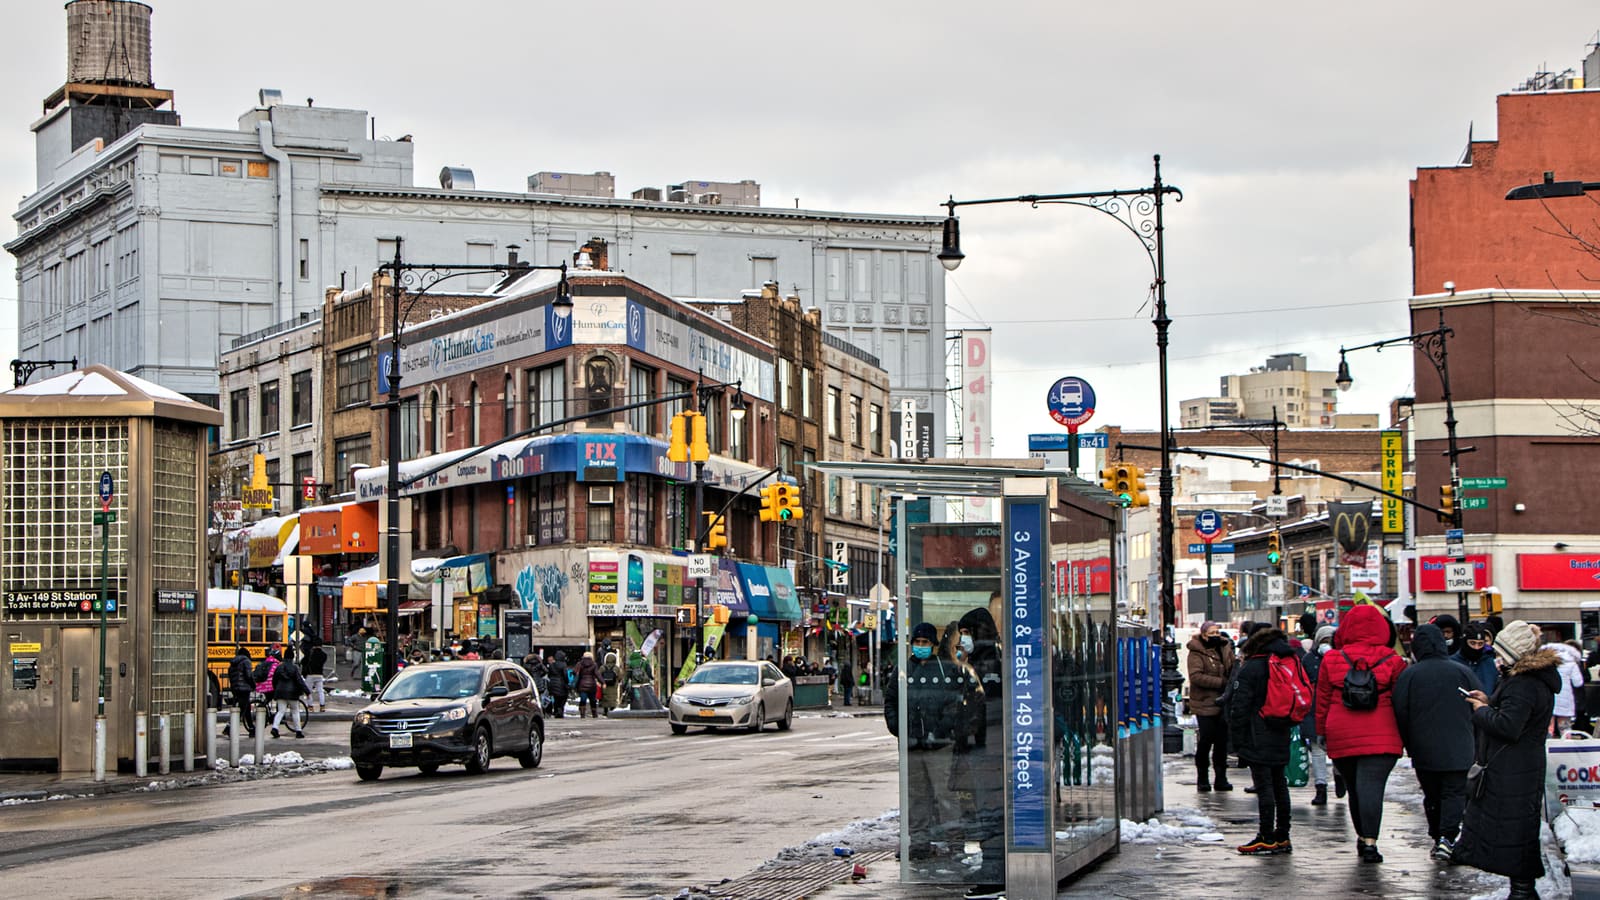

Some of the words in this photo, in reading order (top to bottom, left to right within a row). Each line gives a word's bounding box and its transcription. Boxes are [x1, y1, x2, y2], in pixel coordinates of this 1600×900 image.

[573, 319, 627, 329] HumanCare
[443, 329, 495, 362] HumanCare
[903, 401, 914, 458] TATTOO
[1080, 437, 1105, 448] Bx41
[585, 443, 616, 460] FIX
[457, 466, 477, 478] Computer
[243, 488, 272, 504] FABRIC
[1463, 499, 1468, 508] E
[1469, 499, 1479, 508] 149
[1014, 531, 1031, 542] 3
[1423, 561, 1444, 570] Bank
[1570, 560, 1591, 569] Bank
[1453, 567, 1466, 576] NO
[1014, 547, 1031, 619] Avenue
[1447, 578, 1473, 587] TURNS
[8, 593, 15, 601] 3
[16, 592, 50, 601] Av-149
[51, 592, 62, 601] St
[63, 591, 98, 601] Station
[32, 601, 41, 609] St
[50, 601, 67, 609] Dyre
[1015, 624, 1032, 637] &
[1015, 644, 1032, 686] East
[1015, 691, 1032, 725] 149
[1016, 732, 1033, 789] Street
[1556, 764, 1600, 783] COOK
